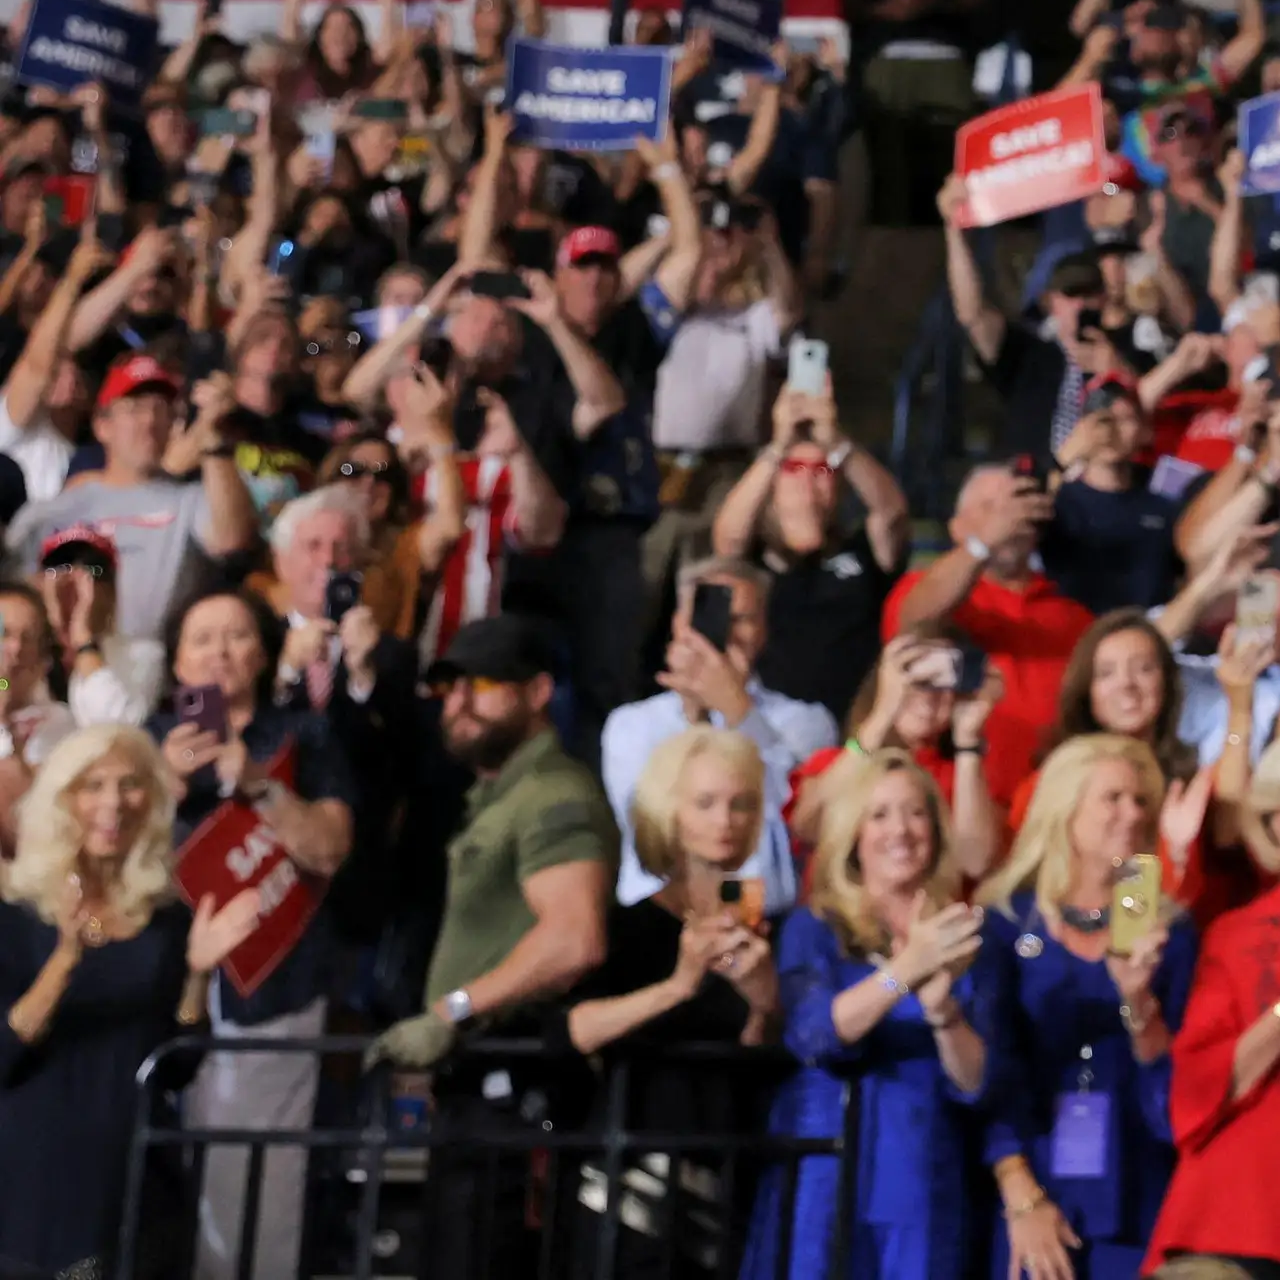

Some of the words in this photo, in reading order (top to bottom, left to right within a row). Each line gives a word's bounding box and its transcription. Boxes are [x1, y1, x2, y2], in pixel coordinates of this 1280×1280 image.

[546, 66, 627, 96] SAVE
[514, 92, 657, 124] AMERICA!
[990, 118, 1061, 159] SAVE
[225, 823, 277, 883] SAV
